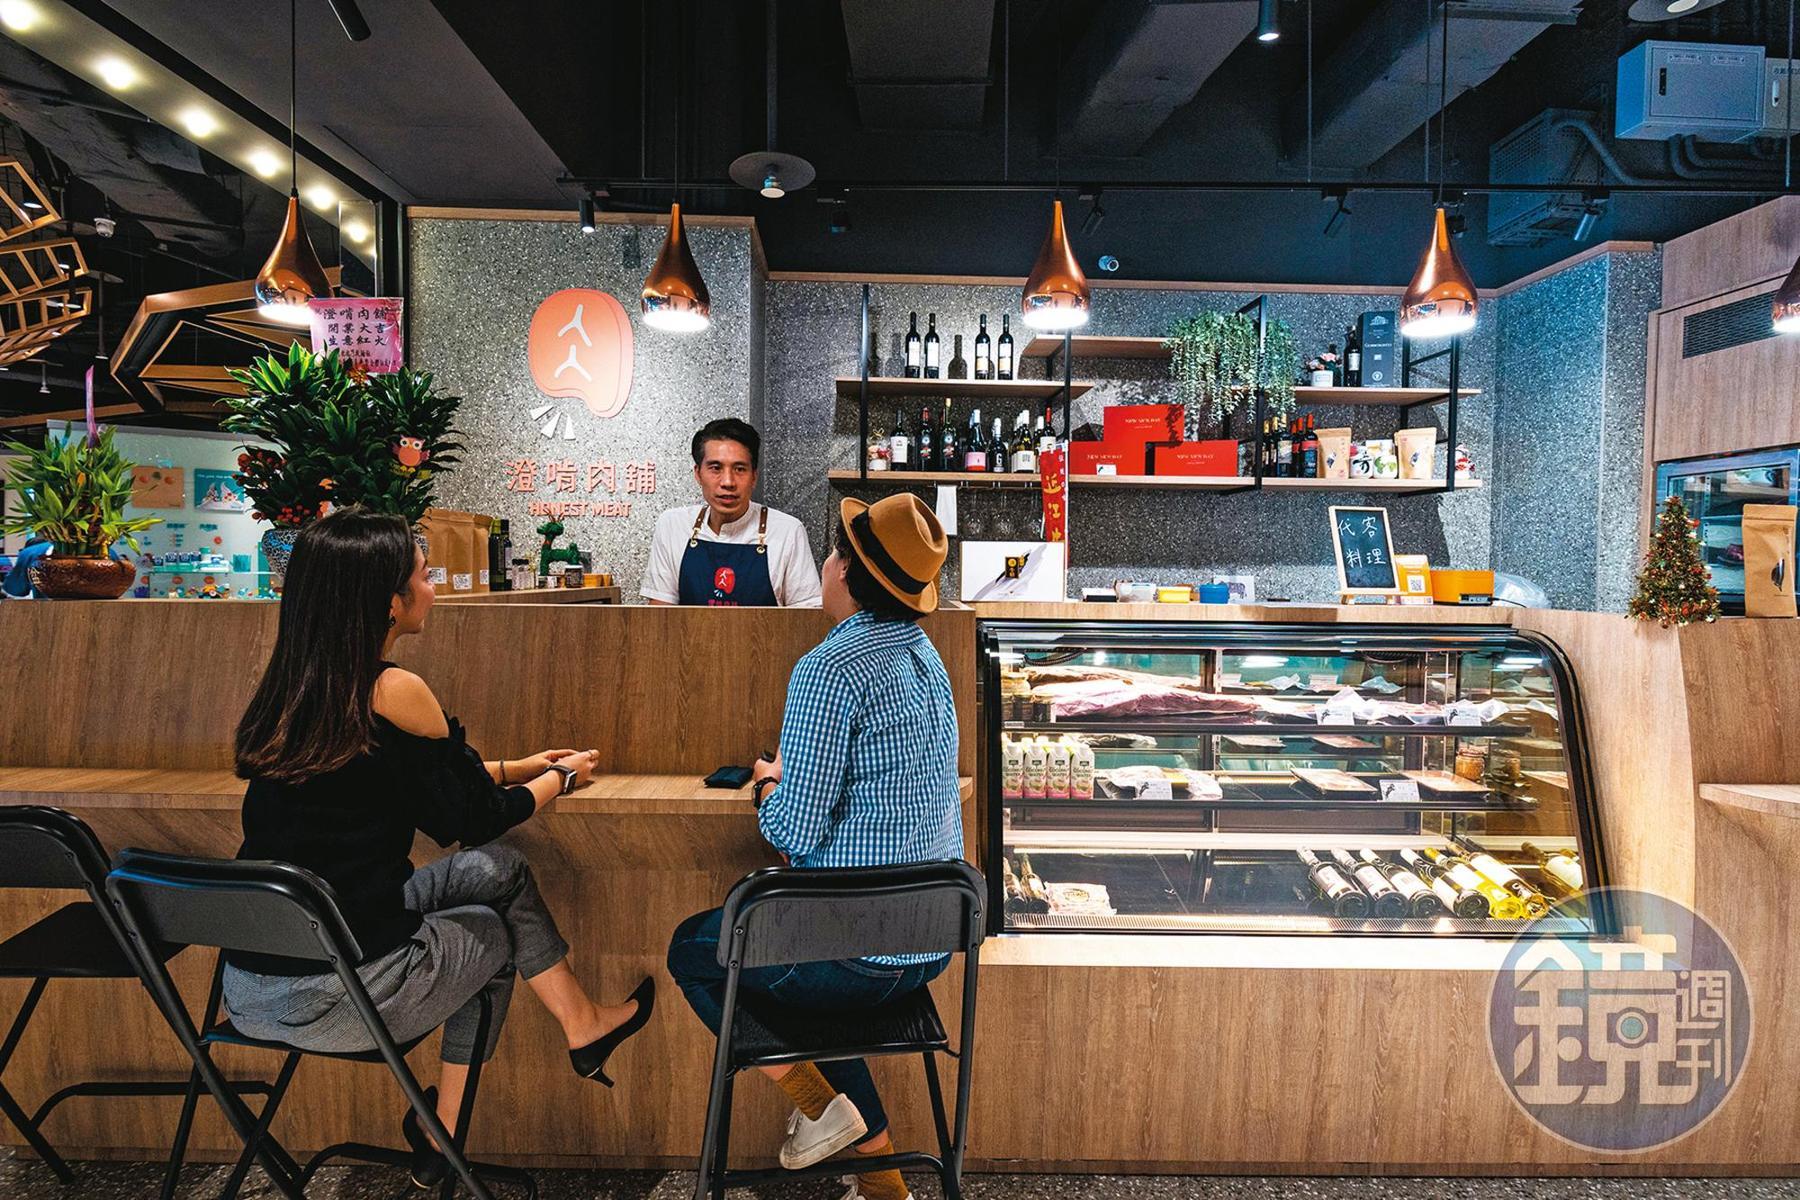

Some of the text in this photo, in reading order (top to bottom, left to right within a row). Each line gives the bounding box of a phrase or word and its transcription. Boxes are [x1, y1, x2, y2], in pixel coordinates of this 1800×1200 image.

[328, 322, 386, 334] 開業大吉
[328, 335, 387, 347] 生意紅火
[504, 458, 657, 494] 澄啃肉舖
[528, 501, 632, 518] HONEST MEAT
[1338, 516, 1378, 538] 代客
[1346, 548, 1387, 568] 料理
